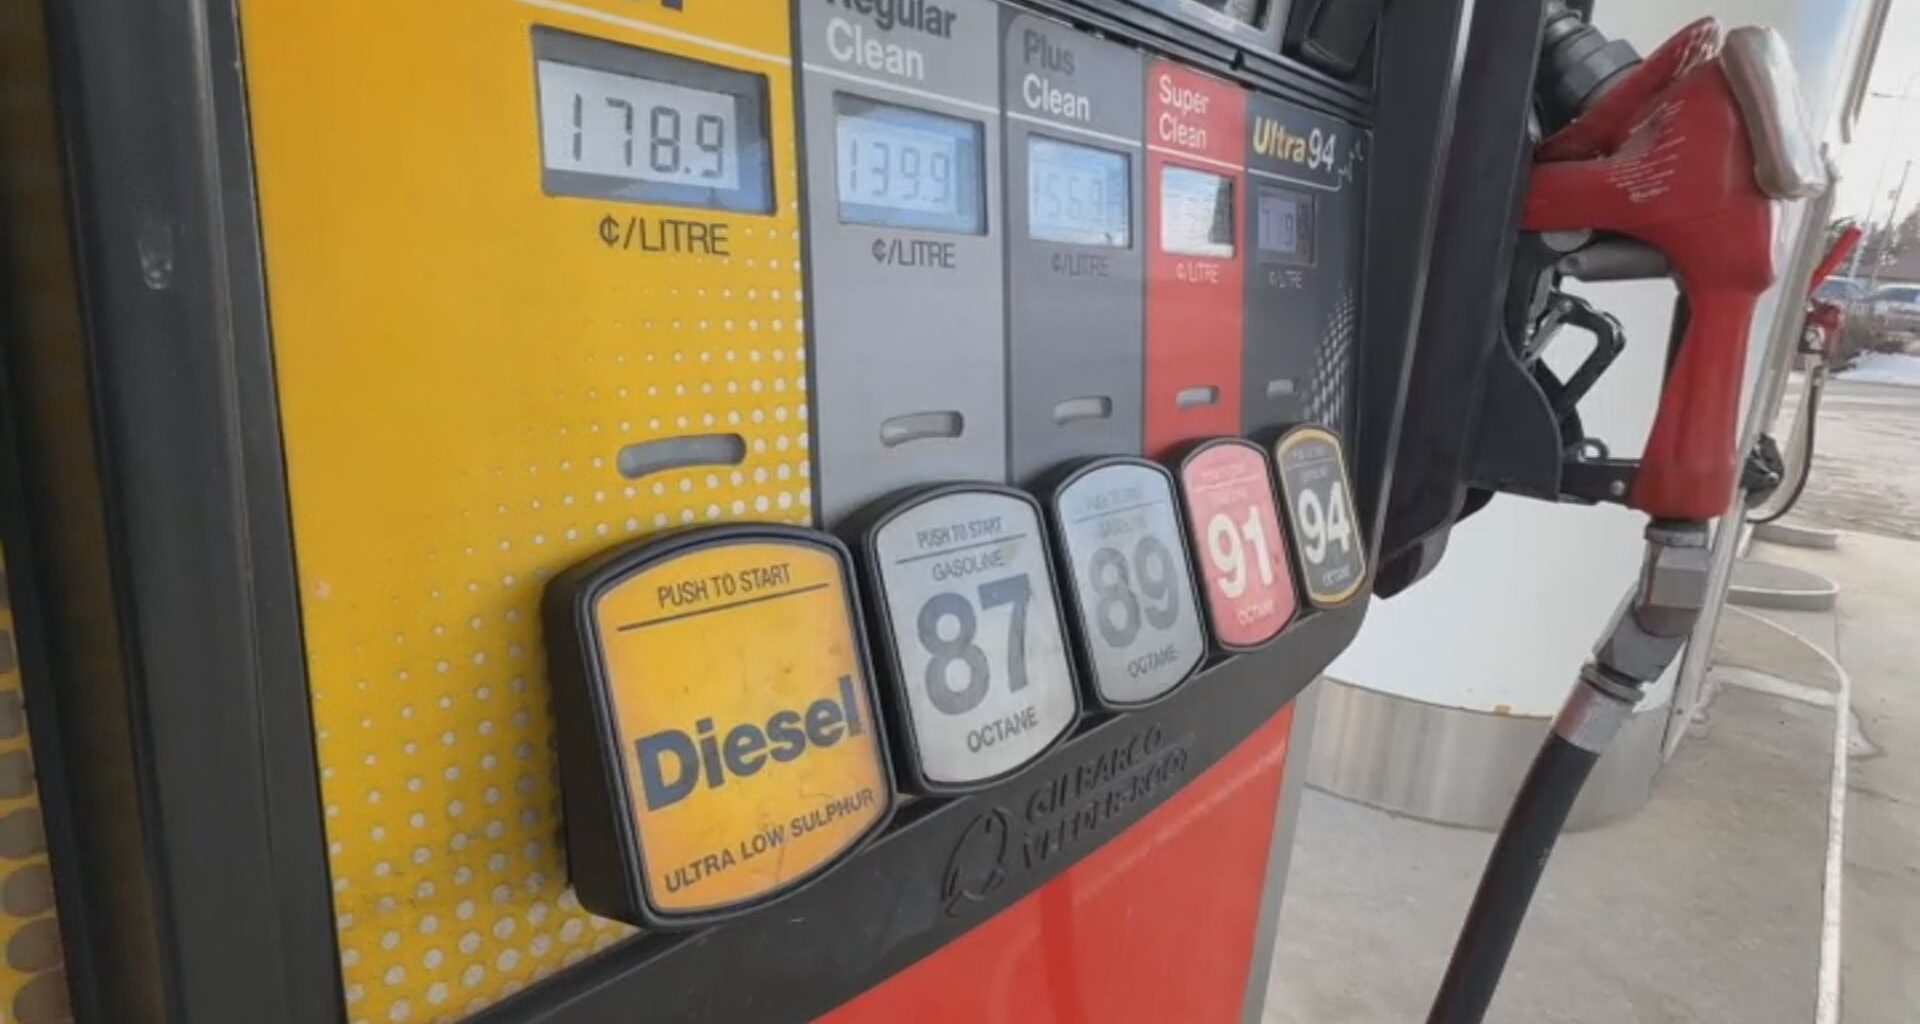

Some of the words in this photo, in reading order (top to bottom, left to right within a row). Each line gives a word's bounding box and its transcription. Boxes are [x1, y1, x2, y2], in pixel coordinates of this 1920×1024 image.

[826, 0, 957, 38] gular
[826, 17, 924, 80] Clean
[1023, 28, 1075, 76] Plus
[1023, 72, 1090, 121] Clean
[1158, 74, 1209, 115] Super
[572, 93, 725, 179] 178.9
[1158, 112, 1207, 149] Clean
[915, 529, 950, 549] PUSH
[969, 516, 1004, 539] START
[1298, 481, 1351, 565] 94
[1207, 505, 1274, 599] 91
[657, 578, 708, 609] PUSH
[710, 572, 737, 599] TO
[739, 563, 790, 593] START
[1089, 534, 1181, 649] 89
[916, 572, 1032, 716] 87
[1126, 644, 1181, 680] OCTANE
[634, 673, 864, 813] Diesel
[966, 706, 1040, 753] OCTANE
[664, 848, 738, 894] ULTRA
[739, 825, 788, 862] LOW
[789, 787, 877, 839] SULPHUR
